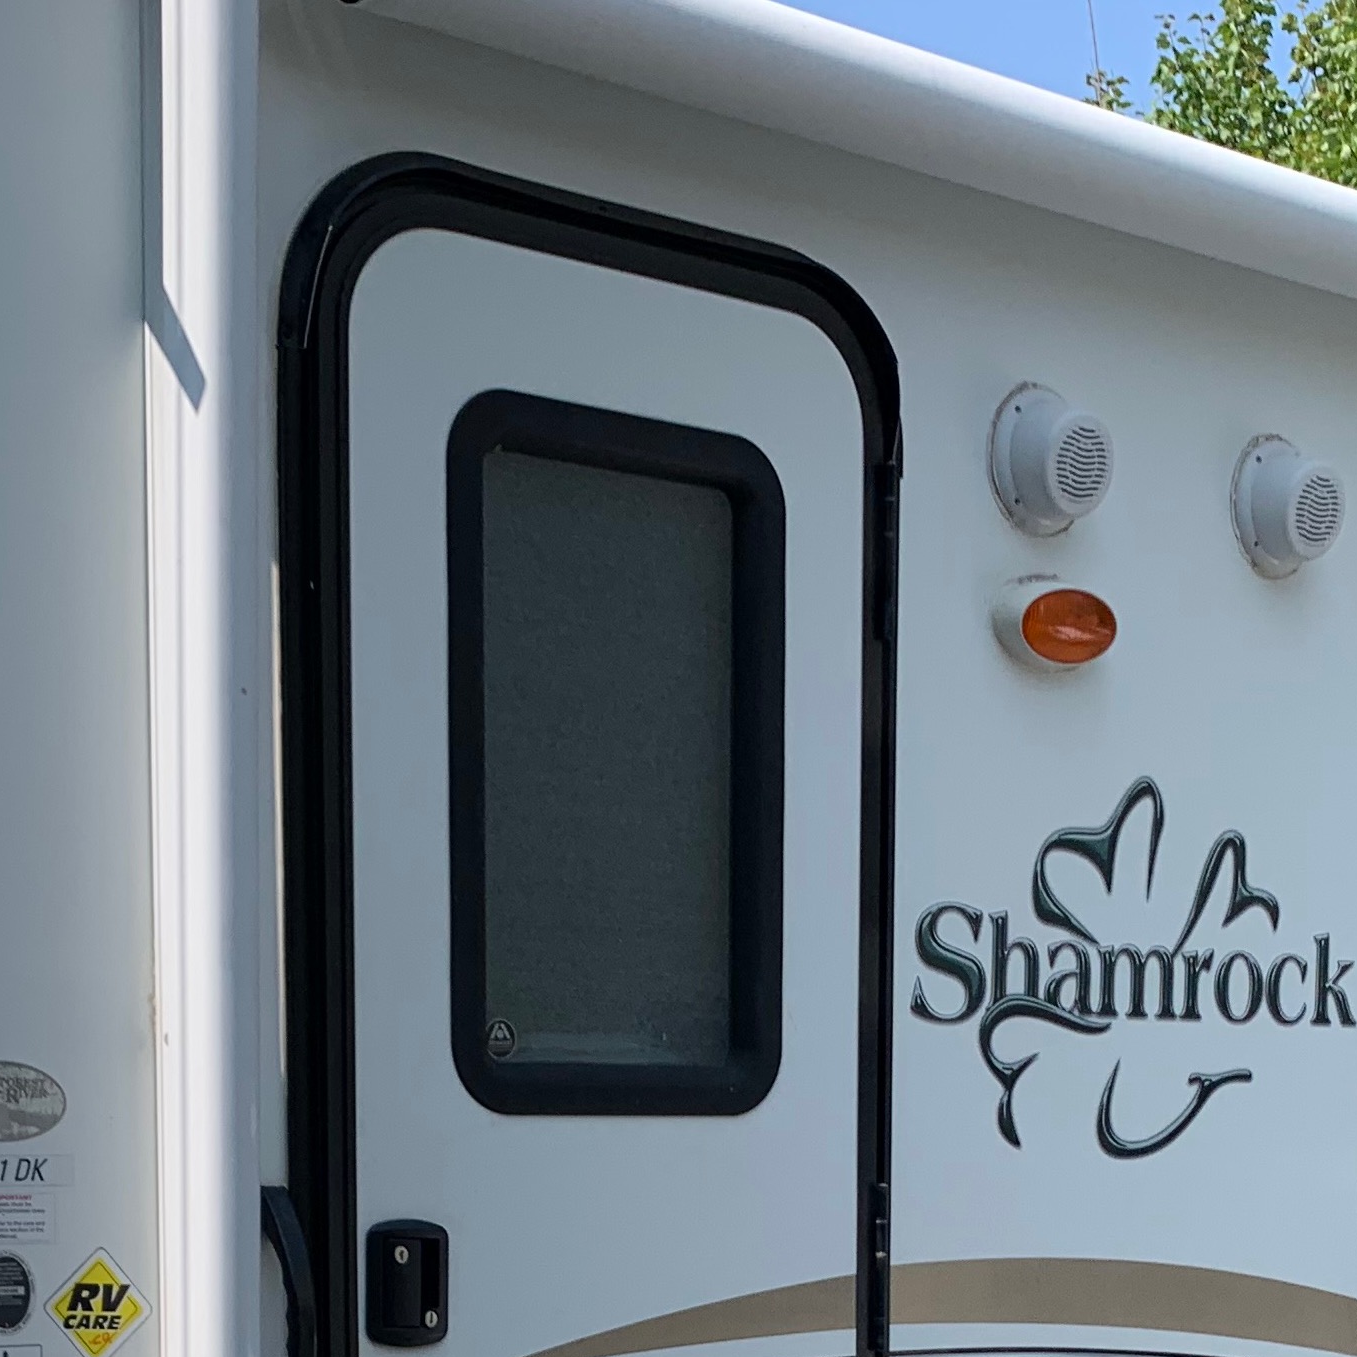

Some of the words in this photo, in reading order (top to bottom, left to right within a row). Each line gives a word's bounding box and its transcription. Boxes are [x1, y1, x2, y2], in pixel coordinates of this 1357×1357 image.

[910, 901, 1357, 1028] Shamrock
[14, 1158, 48, 1181] DK
[67, 1283, 131, 1312] RV
[63, 1314, 122, 1330] CARE
